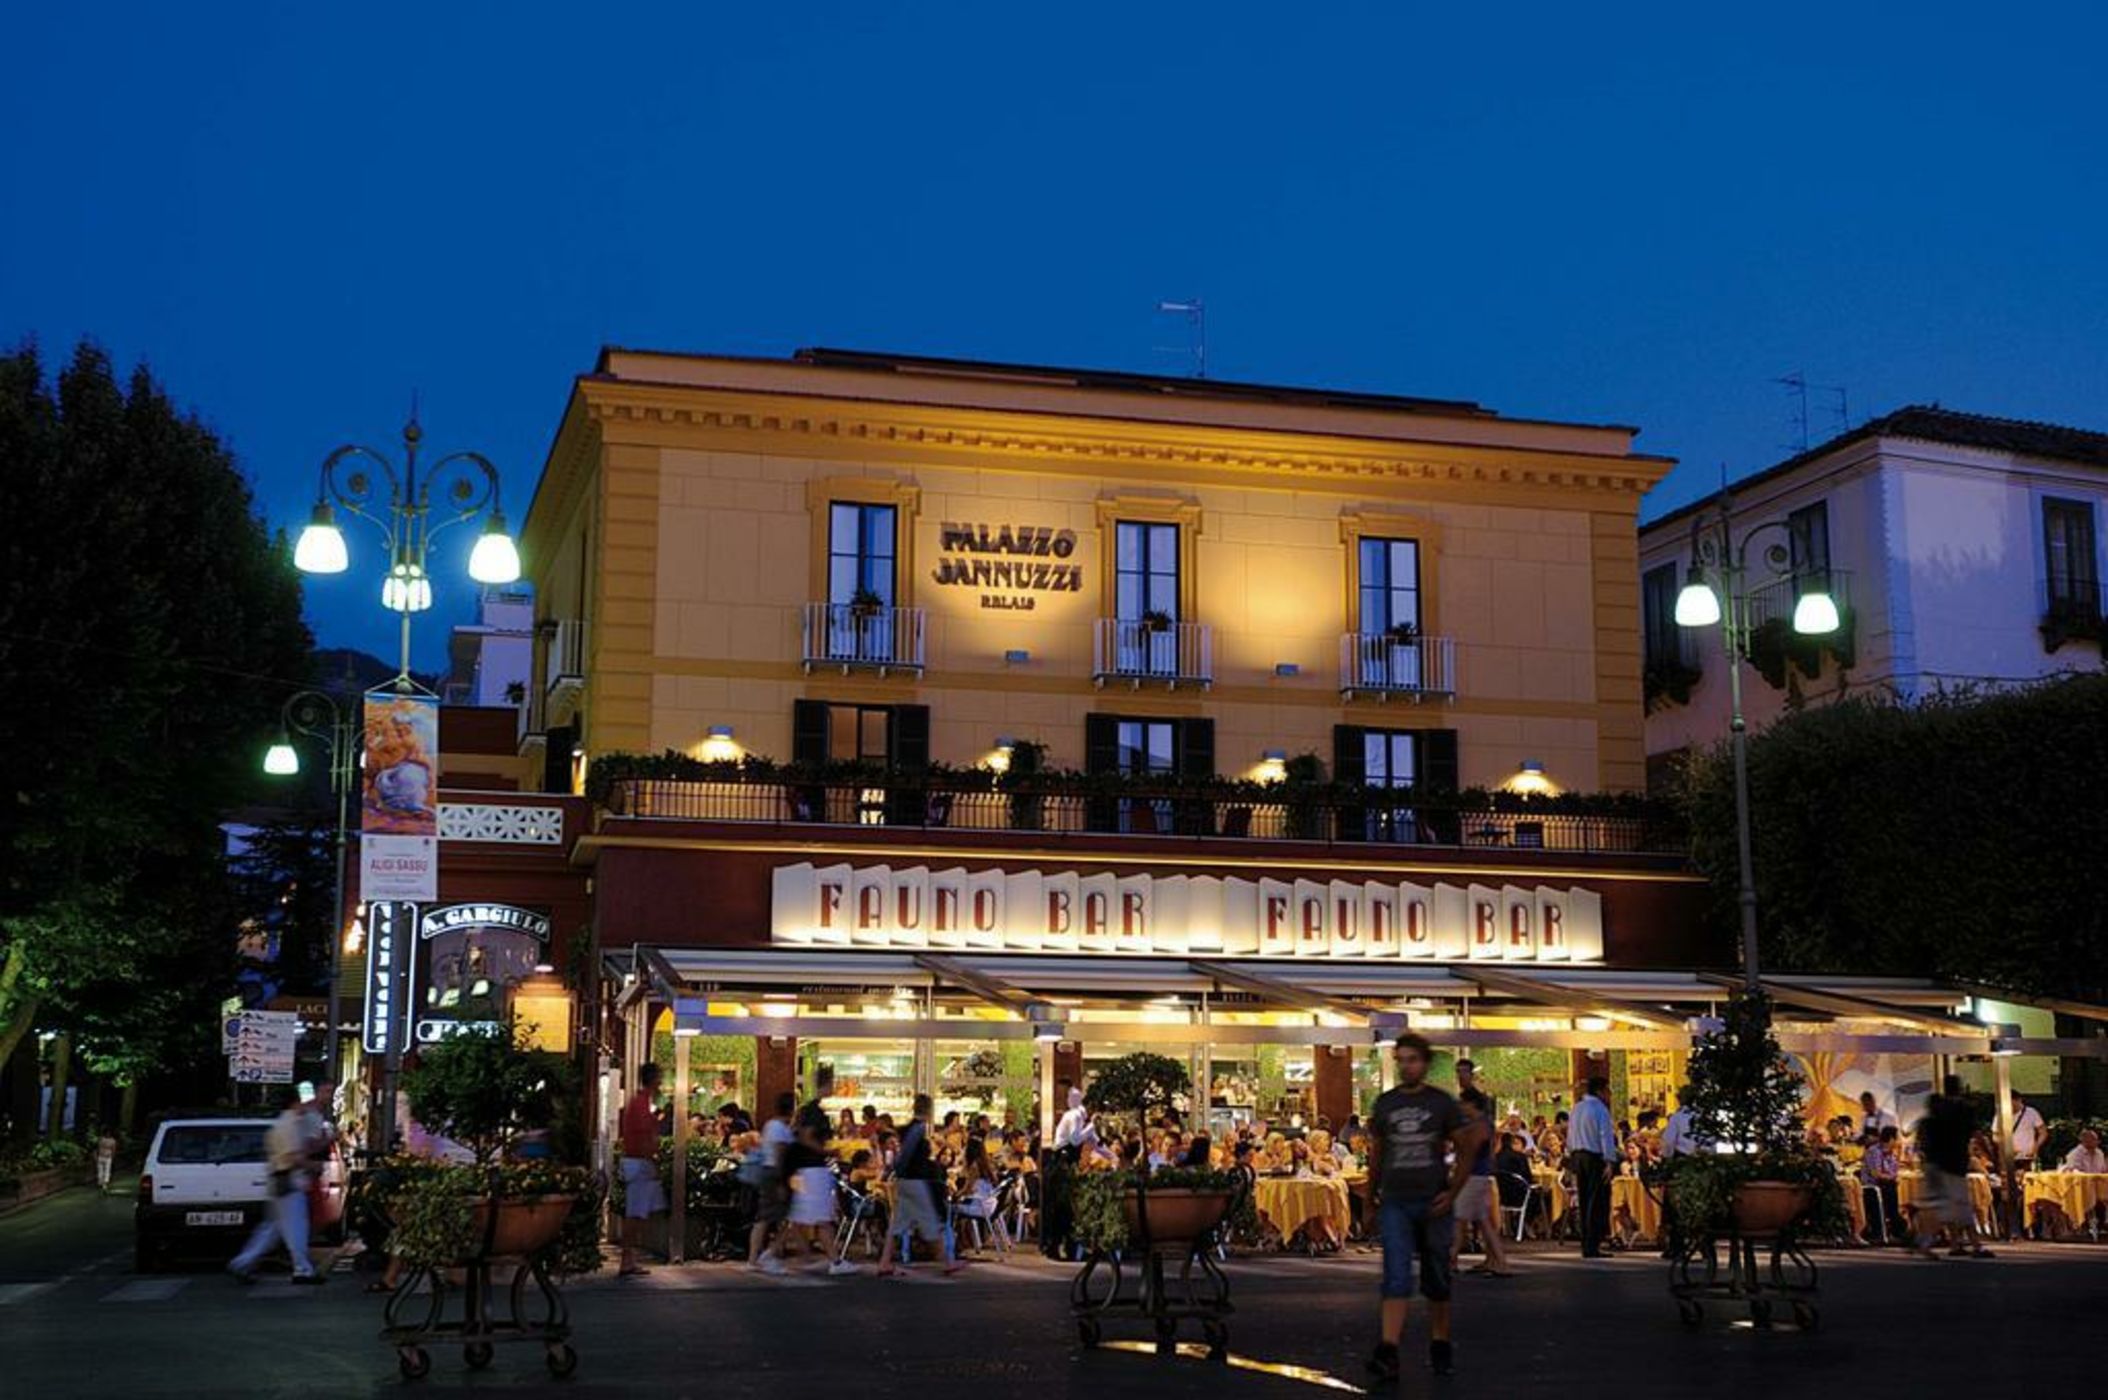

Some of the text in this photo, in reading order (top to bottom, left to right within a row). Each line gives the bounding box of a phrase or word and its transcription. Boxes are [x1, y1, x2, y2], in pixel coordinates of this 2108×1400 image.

[940, 523, 1077, 558] PALAZZO
[932, 558, 1082, 591] JANNUZZI
[981, 595, 1034, 610] RELAIS
[445, 907, 547, 934] GARGIULO
[820, 884, 1143, 936] FAUNO BAR
[1267, 897, 1562, 946] FAUNO BAR
